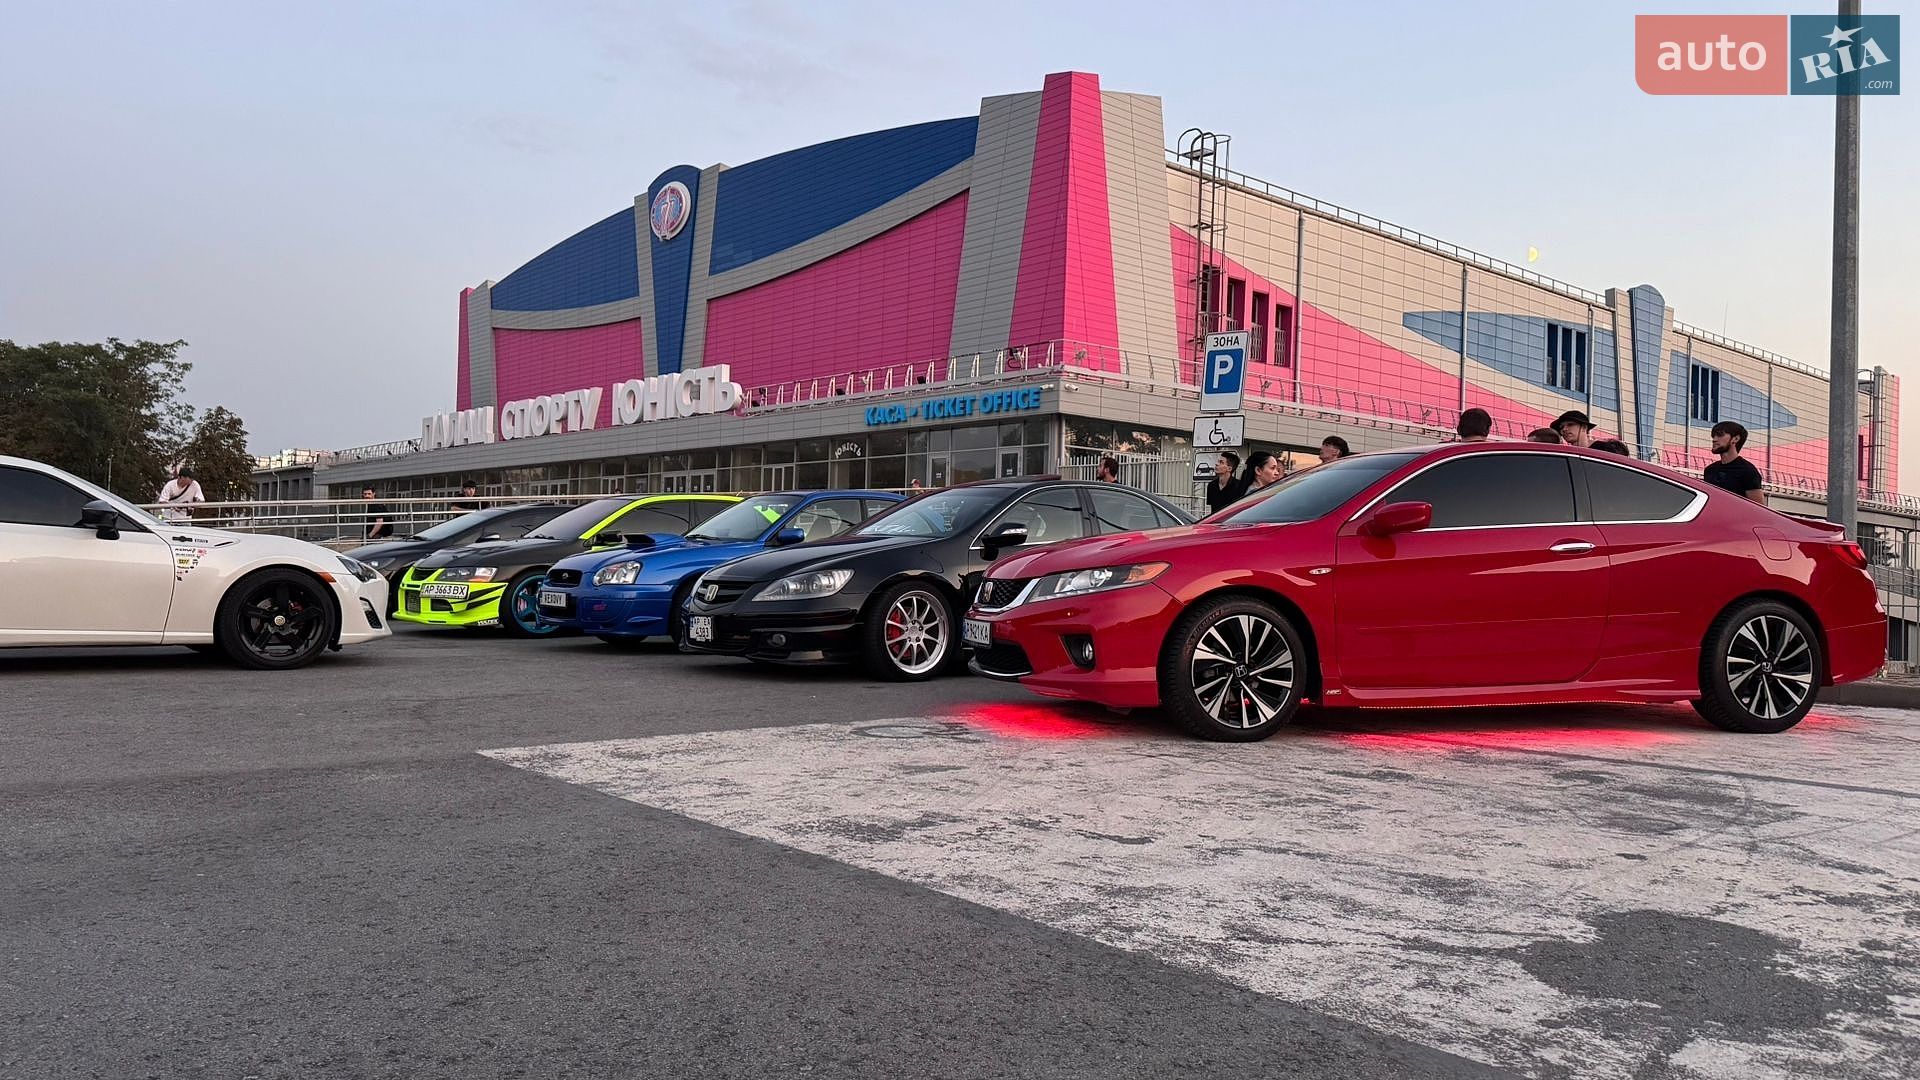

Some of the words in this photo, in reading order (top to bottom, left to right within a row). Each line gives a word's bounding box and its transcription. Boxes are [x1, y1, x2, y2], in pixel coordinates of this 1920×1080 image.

[1213, 336, 1240, 347] ЗОНА
[1213, 355, 1233, 388] P
[422, 406, 495, 451] ПАЛАЦ
[501, 387, 603, 440] СПОРТУ
[611, 364, 741, 426] ЮНІСТЬ
[864, 405, 907, 426] КАСА
[922, 395, 976, 419] TICKET
[981, 387, 1041, 413] OFFICE
